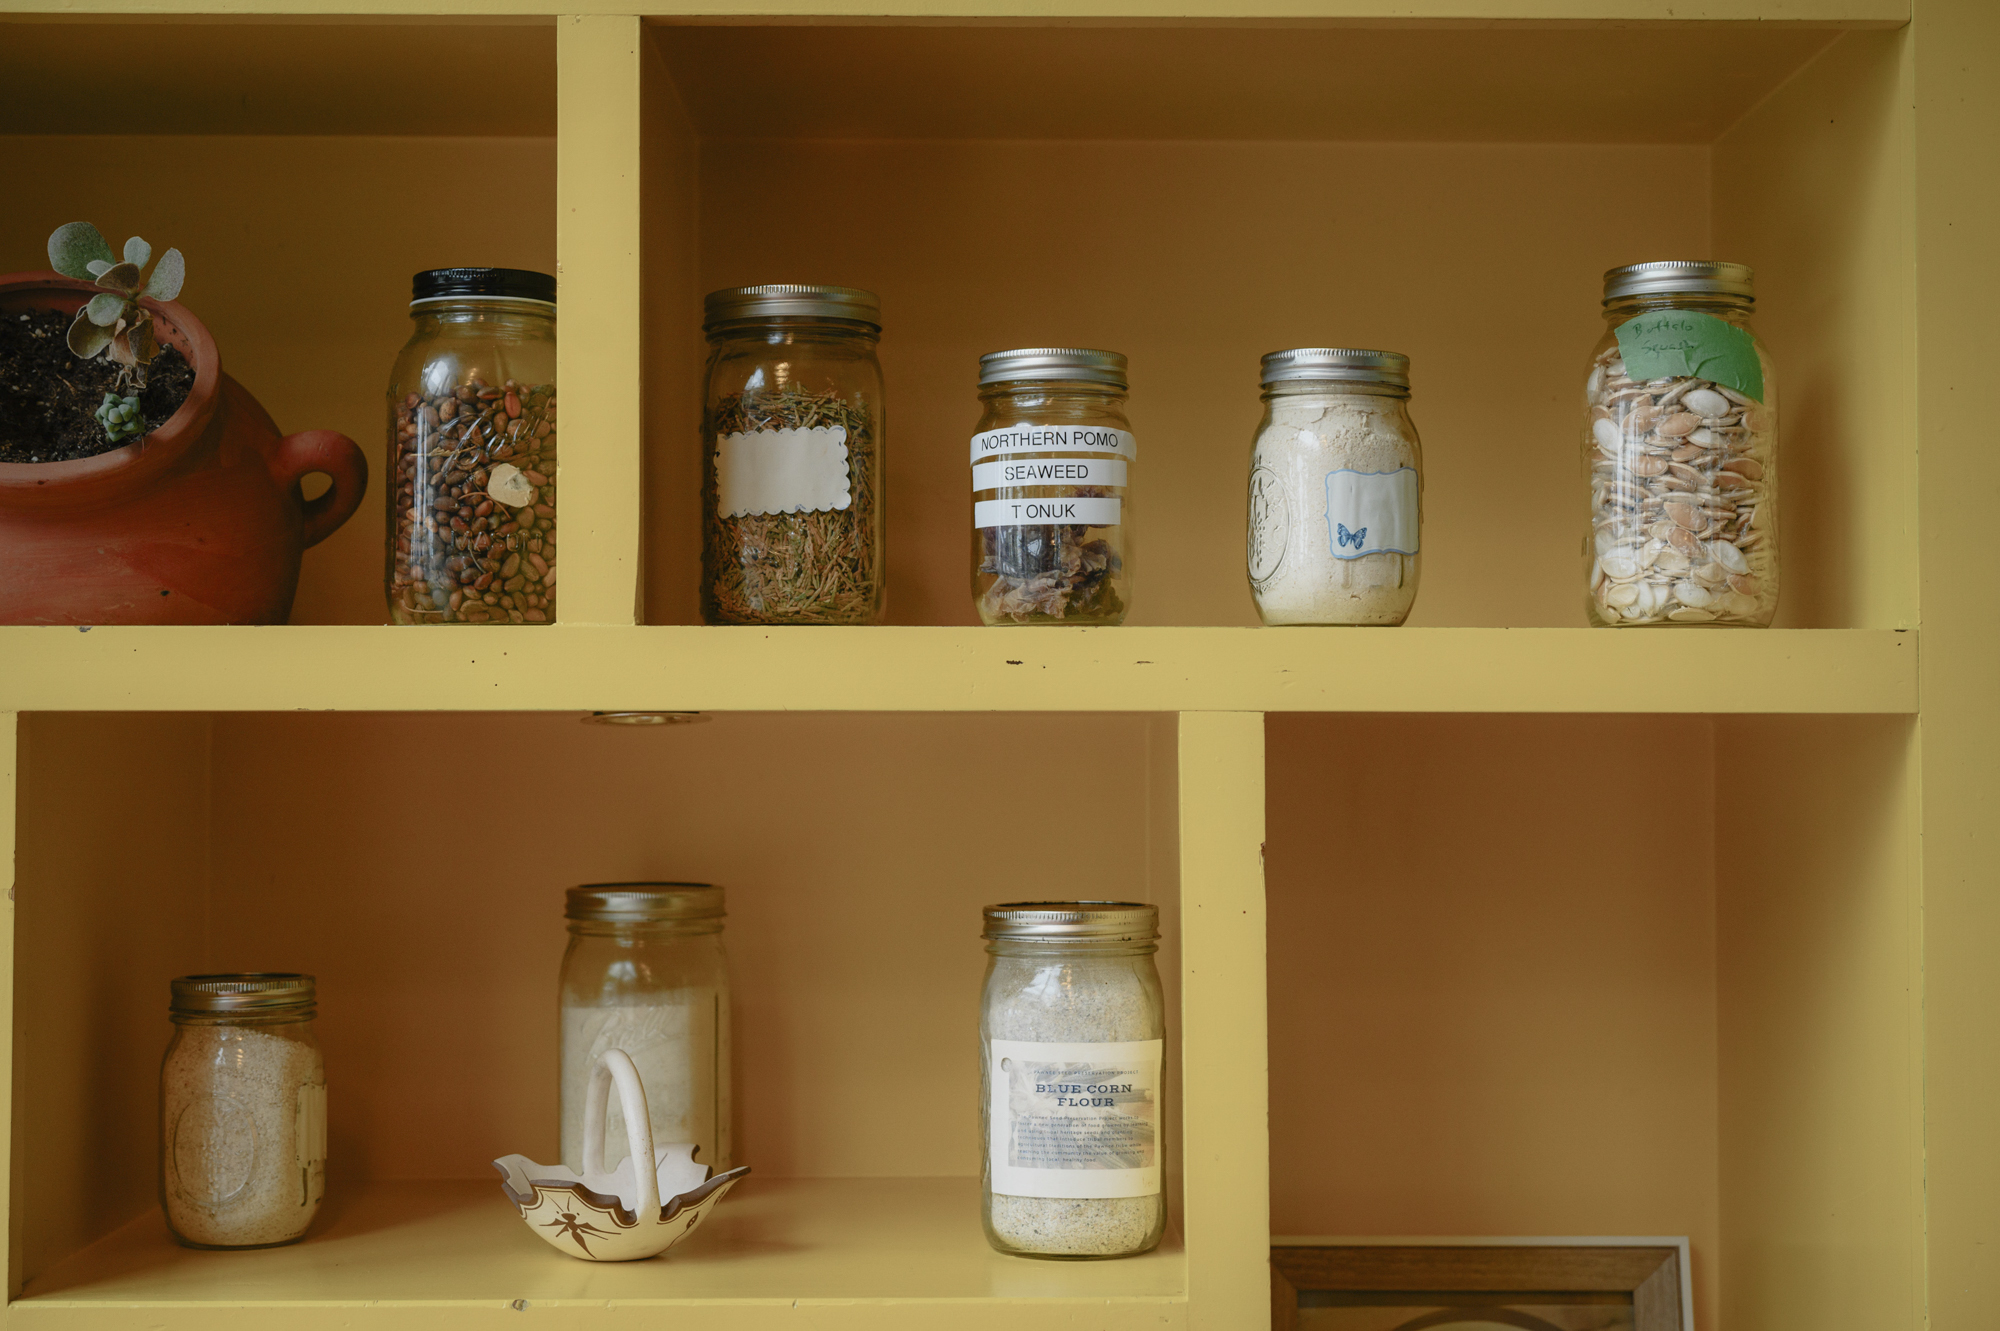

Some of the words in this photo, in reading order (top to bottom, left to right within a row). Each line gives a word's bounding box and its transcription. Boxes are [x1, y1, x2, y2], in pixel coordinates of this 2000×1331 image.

[981, 431, 1067, 452] NORTHERN
[1073, 431, 1119, 448] POMO
[1004, 465, 1089, 481] SEAWEED
[1035, 1084, 1082, 1094] BLUE
[1086, 1083, 1133, 1094] CORN
[1057, 1097, 1115, 1108] FLOUR
